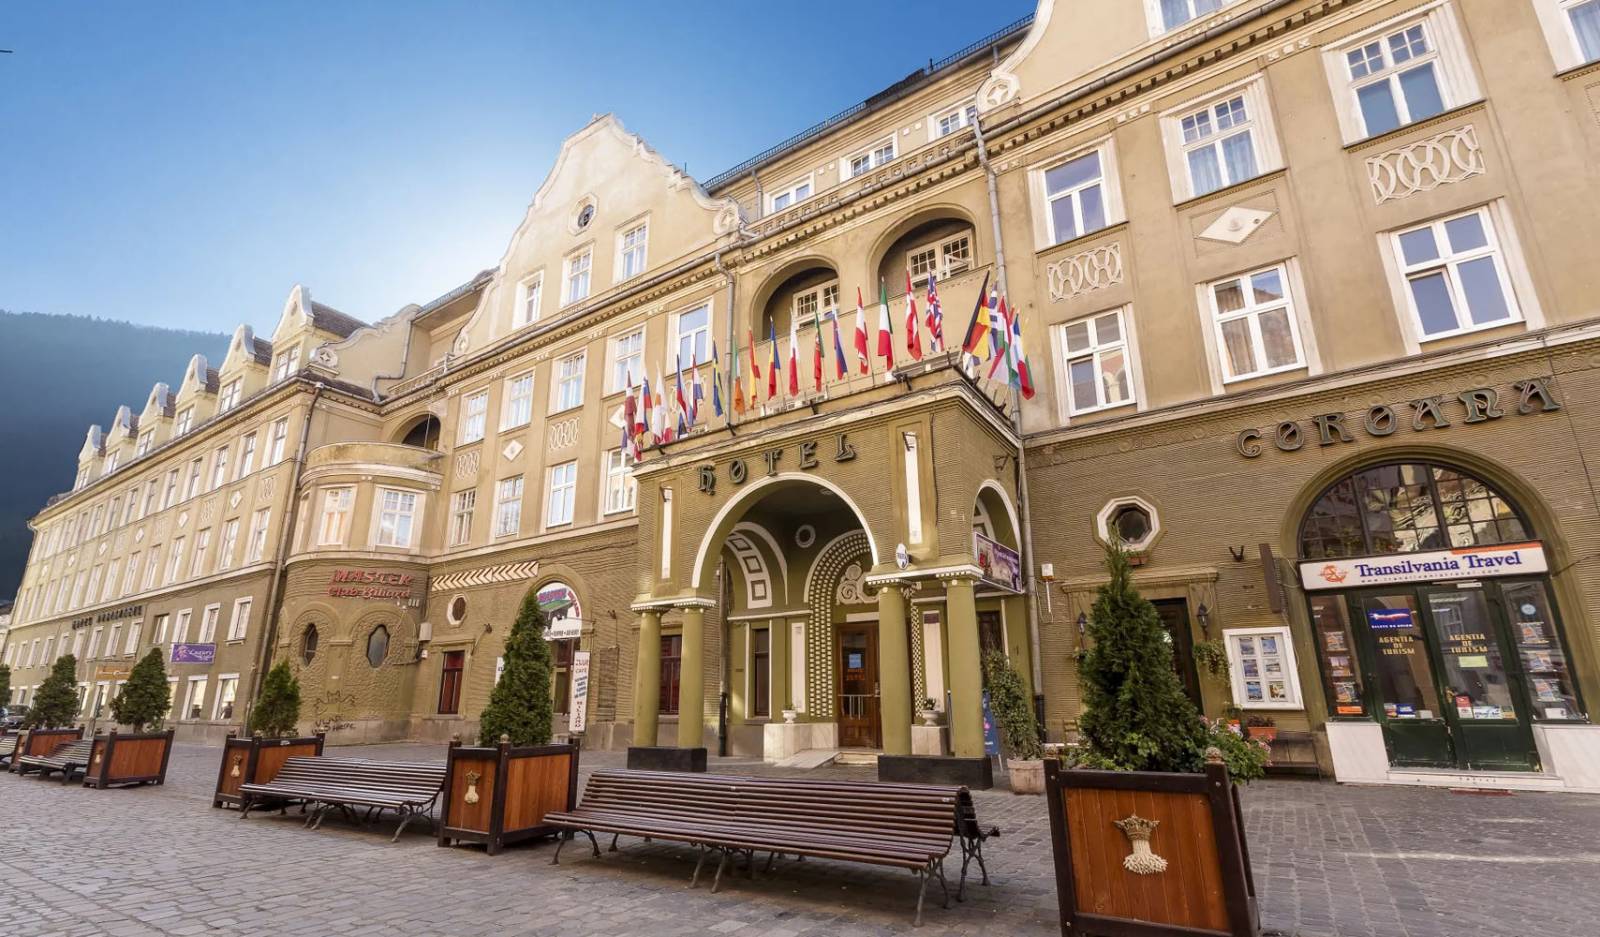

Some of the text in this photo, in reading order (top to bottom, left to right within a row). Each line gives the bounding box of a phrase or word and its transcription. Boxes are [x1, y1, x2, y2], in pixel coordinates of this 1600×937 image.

[1235, 376, 1561, 458] COROANA
[697, 433, 857, 496] HOTEL
[334, 568, 412, 585] MASTER
[1355, 551, 1522, 578] Transilvania Travel
